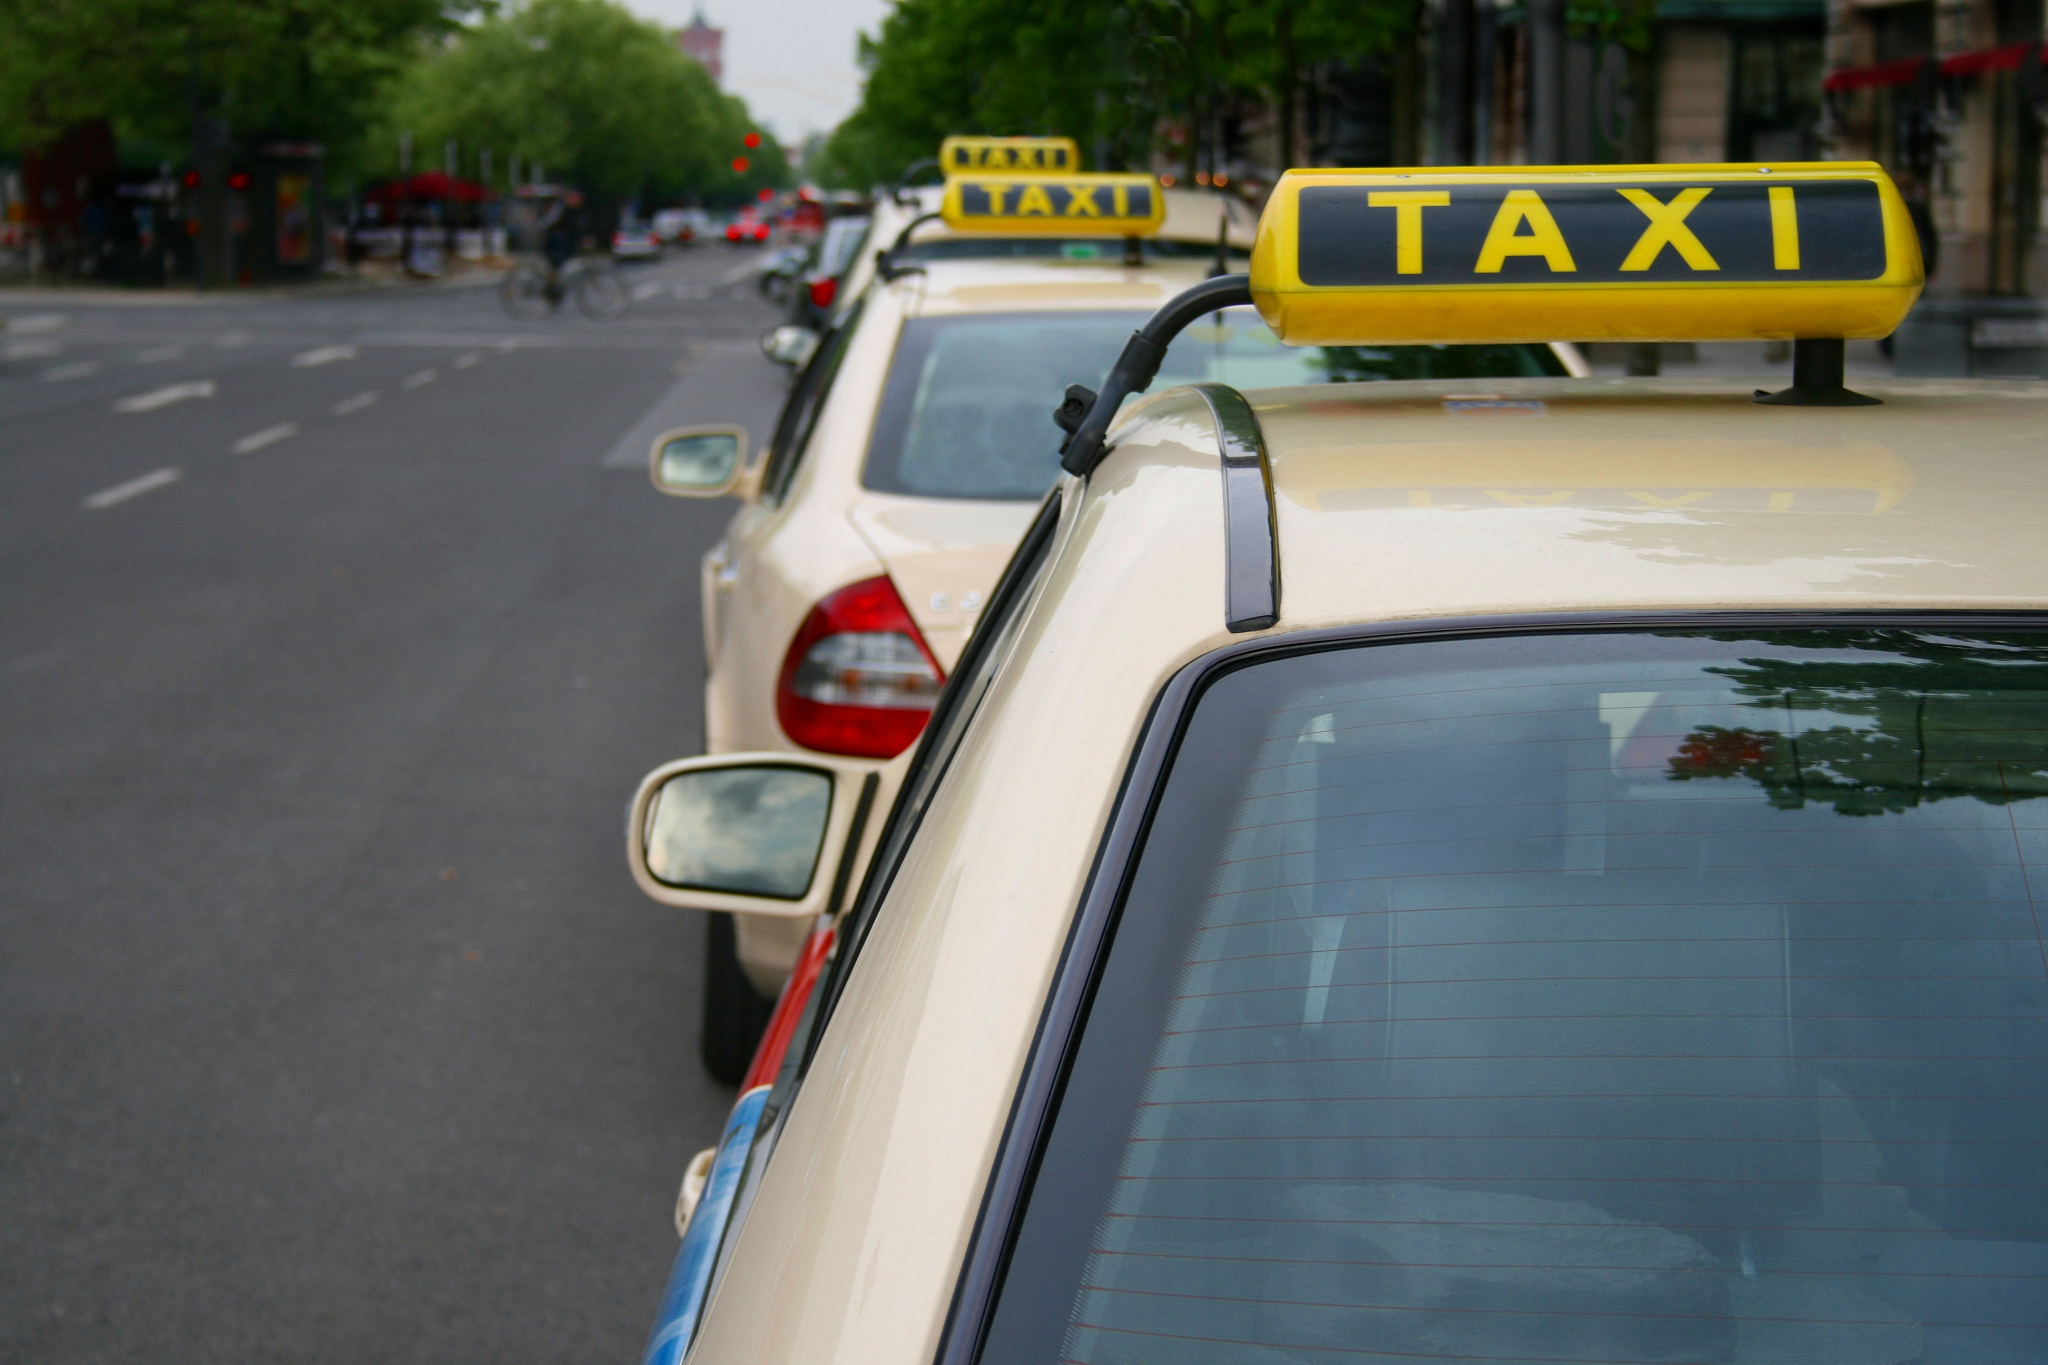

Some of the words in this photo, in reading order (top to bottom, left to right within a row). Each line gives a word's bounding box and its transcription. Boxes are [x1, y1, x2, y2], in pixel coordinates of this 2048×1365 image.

[965, 148, 1059, 168] TAXI
[979, 185, 1129, 217] TAXI
[1367, 187, 1801, 275] TAXI
